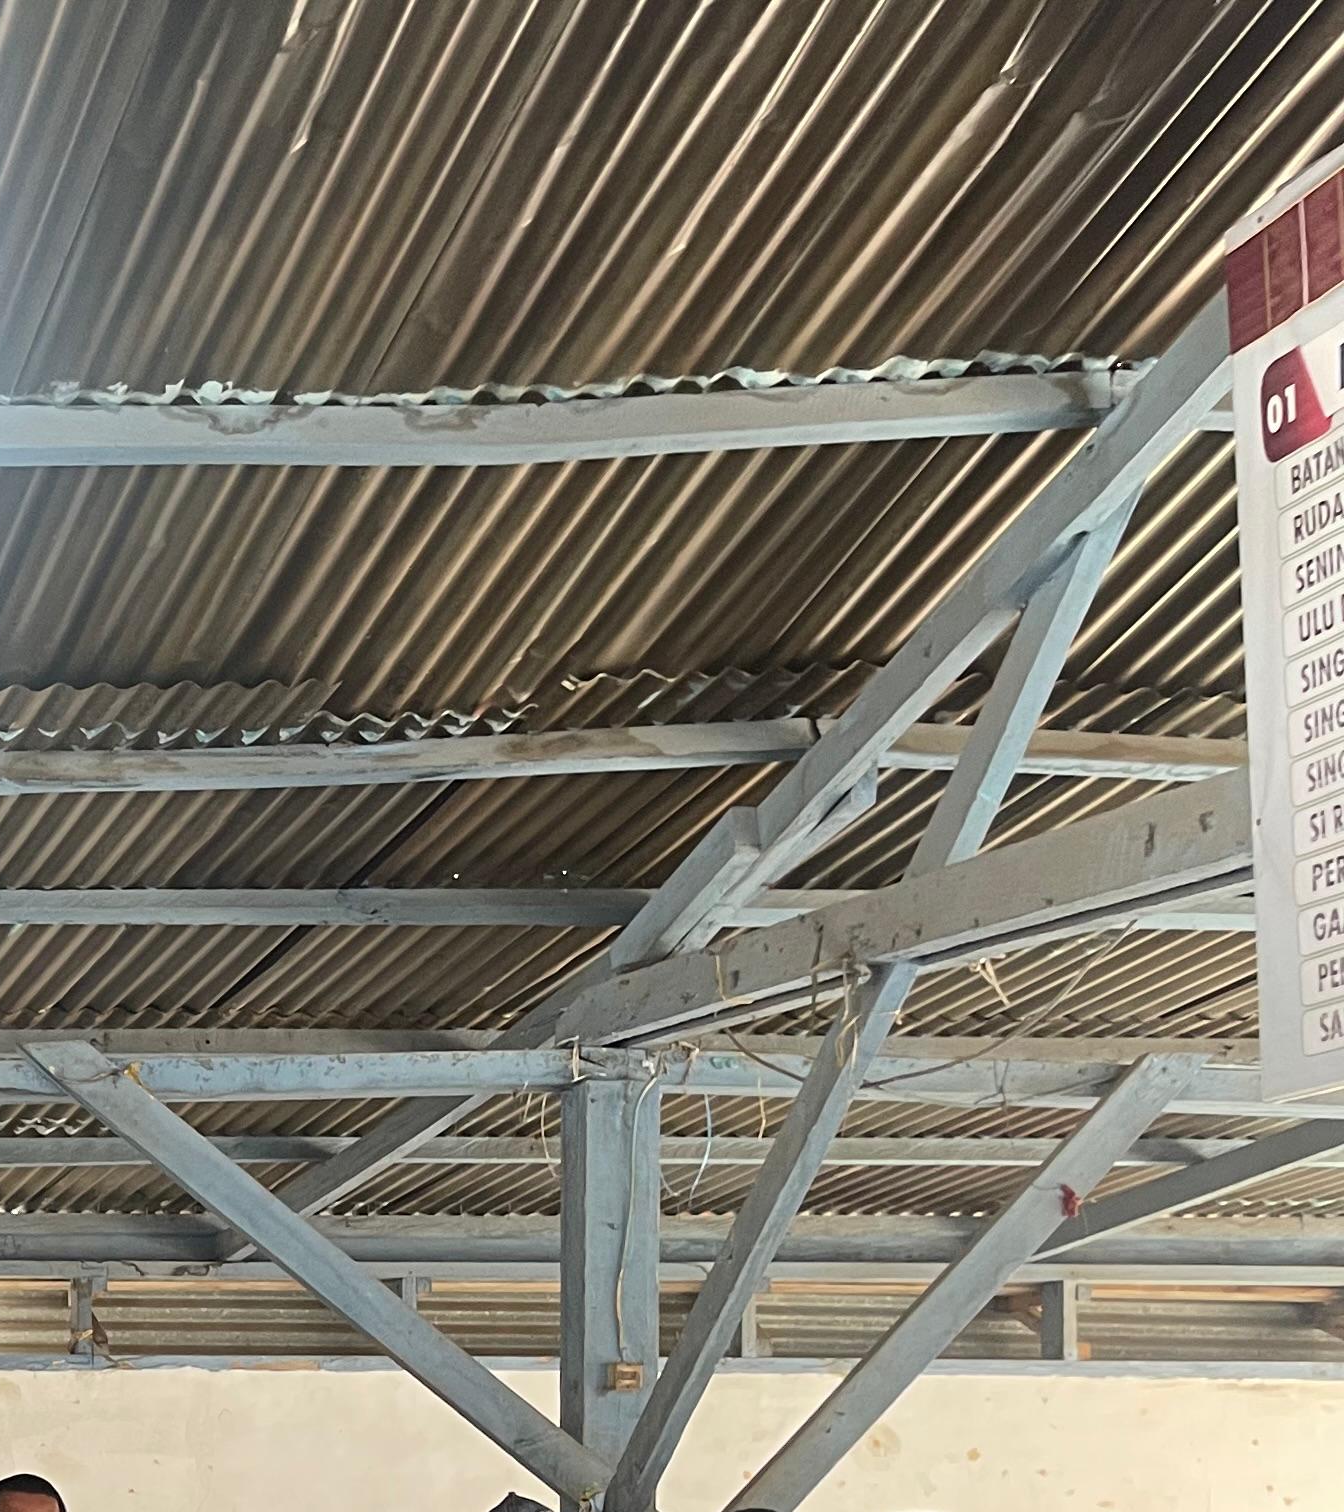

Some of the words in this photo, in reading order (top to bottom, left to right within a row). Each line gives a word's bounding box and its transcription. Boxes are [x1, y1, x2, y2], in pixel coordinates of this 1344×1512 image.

[1266, 383, 1297, 434] 01
[1293, 492, 1344, 545] RUDA
[1299, 600, 1334, 642] ULU
[1301, 647, 1344, 693] SING
[1313, 908, 1344, 941] GA
[1319, 1010, 1344, 1043] SA
